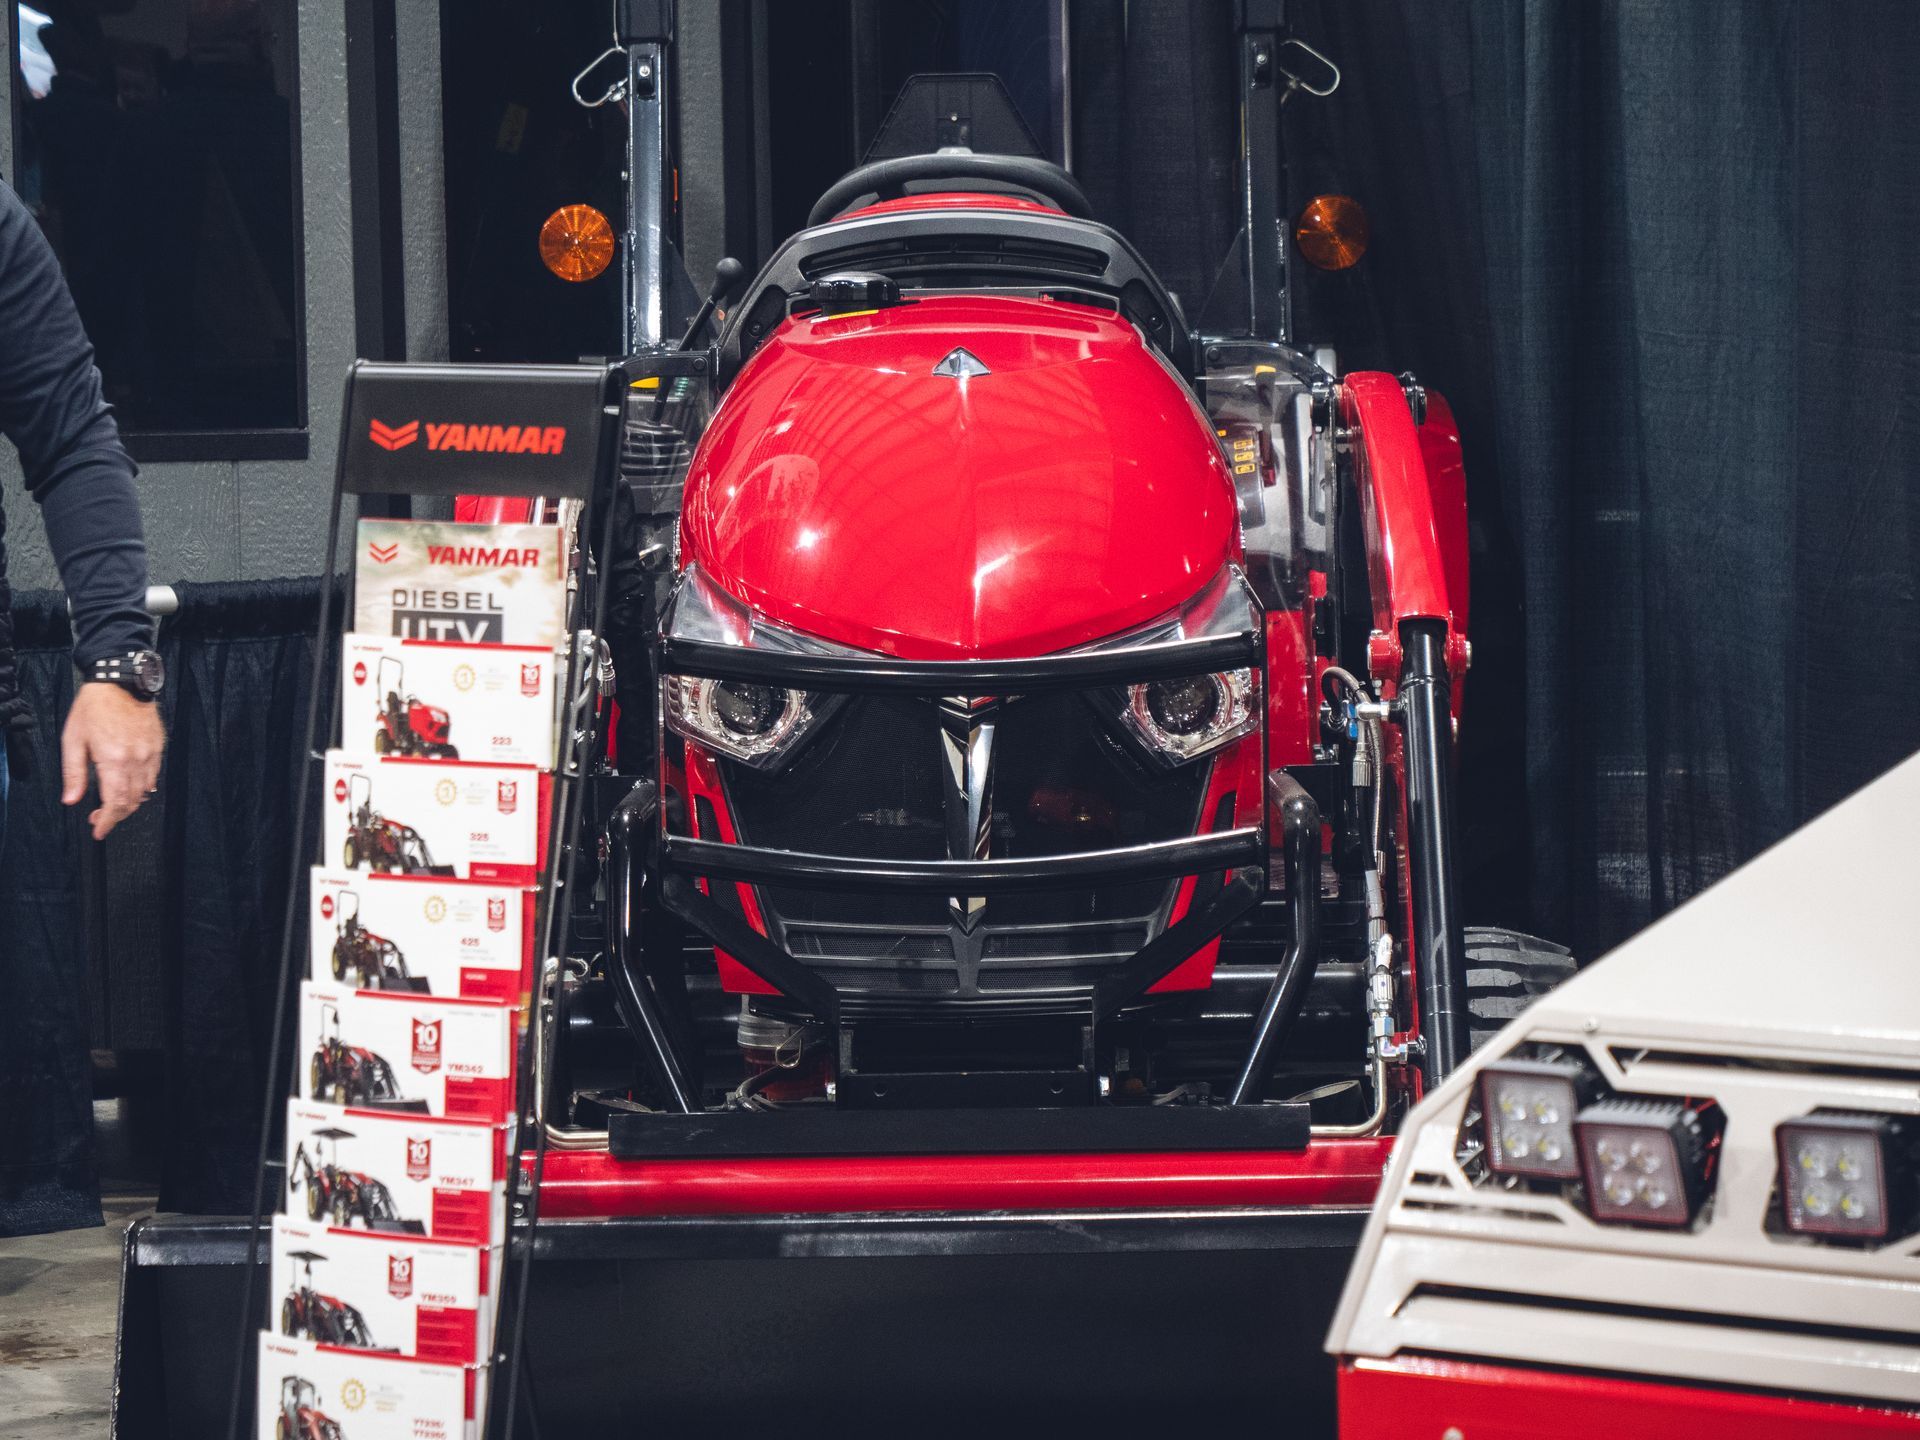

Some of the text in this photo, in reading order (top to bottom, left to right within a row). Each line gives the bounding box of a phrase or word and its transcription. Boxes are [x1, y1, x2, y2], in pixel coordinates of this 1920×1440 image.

[426, 422, 567, 455] YANMAR
[427, 545, 541, 567] YANMAR
[391, 588, 505, 610] DIESEL
[400, 617, 490, 644] UTV
[492, 736, 512, 746] 223
[470, 832, 489, 842] 325
[460, 937, 480, 947] 425
[415, 1025, 438, 1046] 10
[410, 1143, 428, 1160] 10
[439, 1175, 475, 1186] YM347
[391, 1260, 410, 1278] 10
